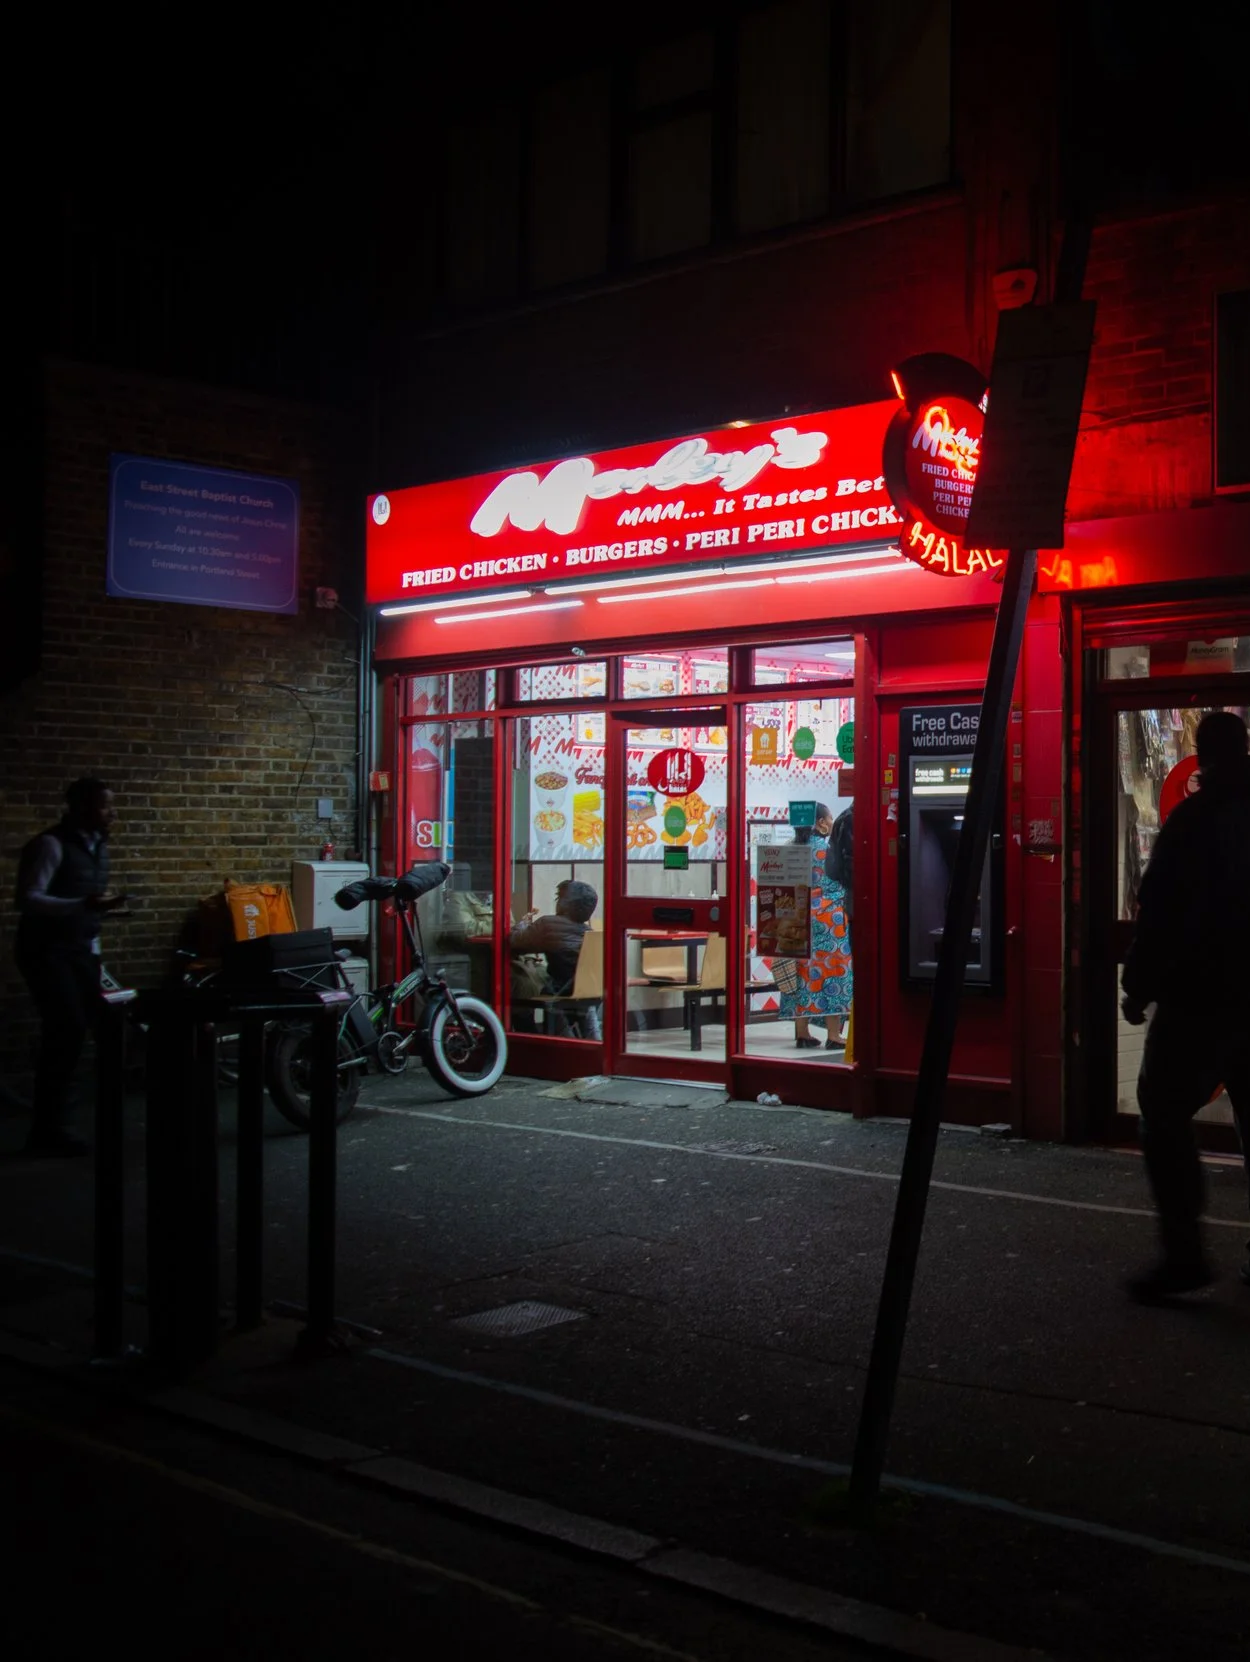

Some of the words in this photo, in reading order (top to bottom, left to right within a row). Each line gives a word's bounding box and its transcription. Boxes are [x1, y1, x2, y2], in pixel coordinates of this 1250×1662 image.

[921, 463, 949, 477] FRIED
[470, 427, 828, 538] Morley's
[140, 480, 163, 493] East
[166, 484, 198, 498] Street
[201, 489, 237, 505] Baptist
[239, 494, 274, 509] Church
[933, 491, 954, 504] PERI
[617, 501, 705, 527] MMM...
[713, 499, 736, 516] It
[742, 486, 828, 511] Tastes
[175, 525, 187, 535] All
[128, 538, 153, 549] Every
[154, 541, 185, 554] Sunday
[402, 567, 456, 588] FRIED
[459, 553, 548, 580] CHICKEN
[565, 537, 668, 566] BURGERS
[686, 527, 739, 550] PERI
[747, 519, 805, 542] PERI
[812, 505, 904, 534] CHICK
[152, 559, 189, 571] Entrance
[190, 562, 199, 572] in
[200, 564, 235, 576] Portland
[236, 568, 260, 579] Street
[1190, 646, 1229, 655] MoneyGram
[912, 714, 945, 731] Free
